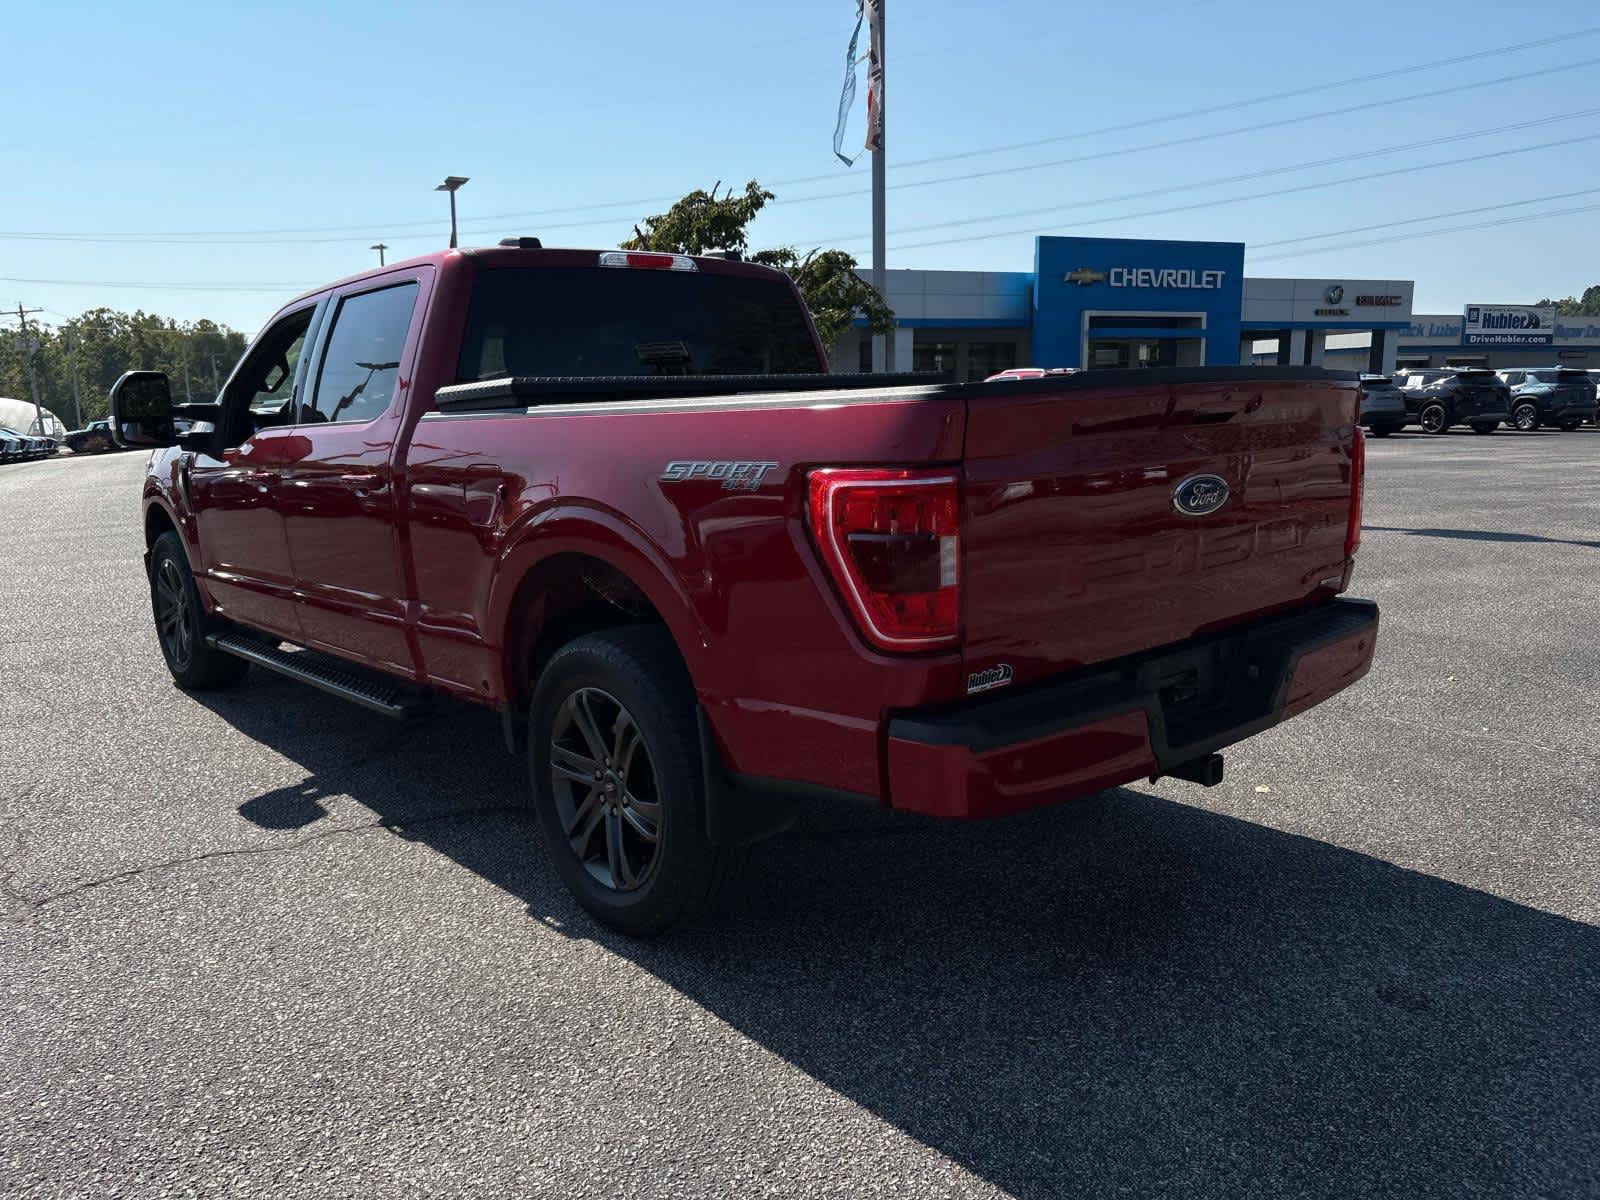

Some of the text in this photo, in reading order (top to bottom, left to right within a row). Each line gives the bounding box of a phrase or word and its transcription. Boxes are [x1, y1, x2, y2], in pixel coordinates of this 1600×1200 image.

[1109, 267, 1225, 289] CHEVROLET
[1481, 313, 1528, 330] Hubler
[1470, 334, 1547, 344] DriveHubler.com
[660, 460, 780, 481] SPORT
[1189, 482, 1220, 507] Ford
[968, 670, 1003, 689] Hubler
